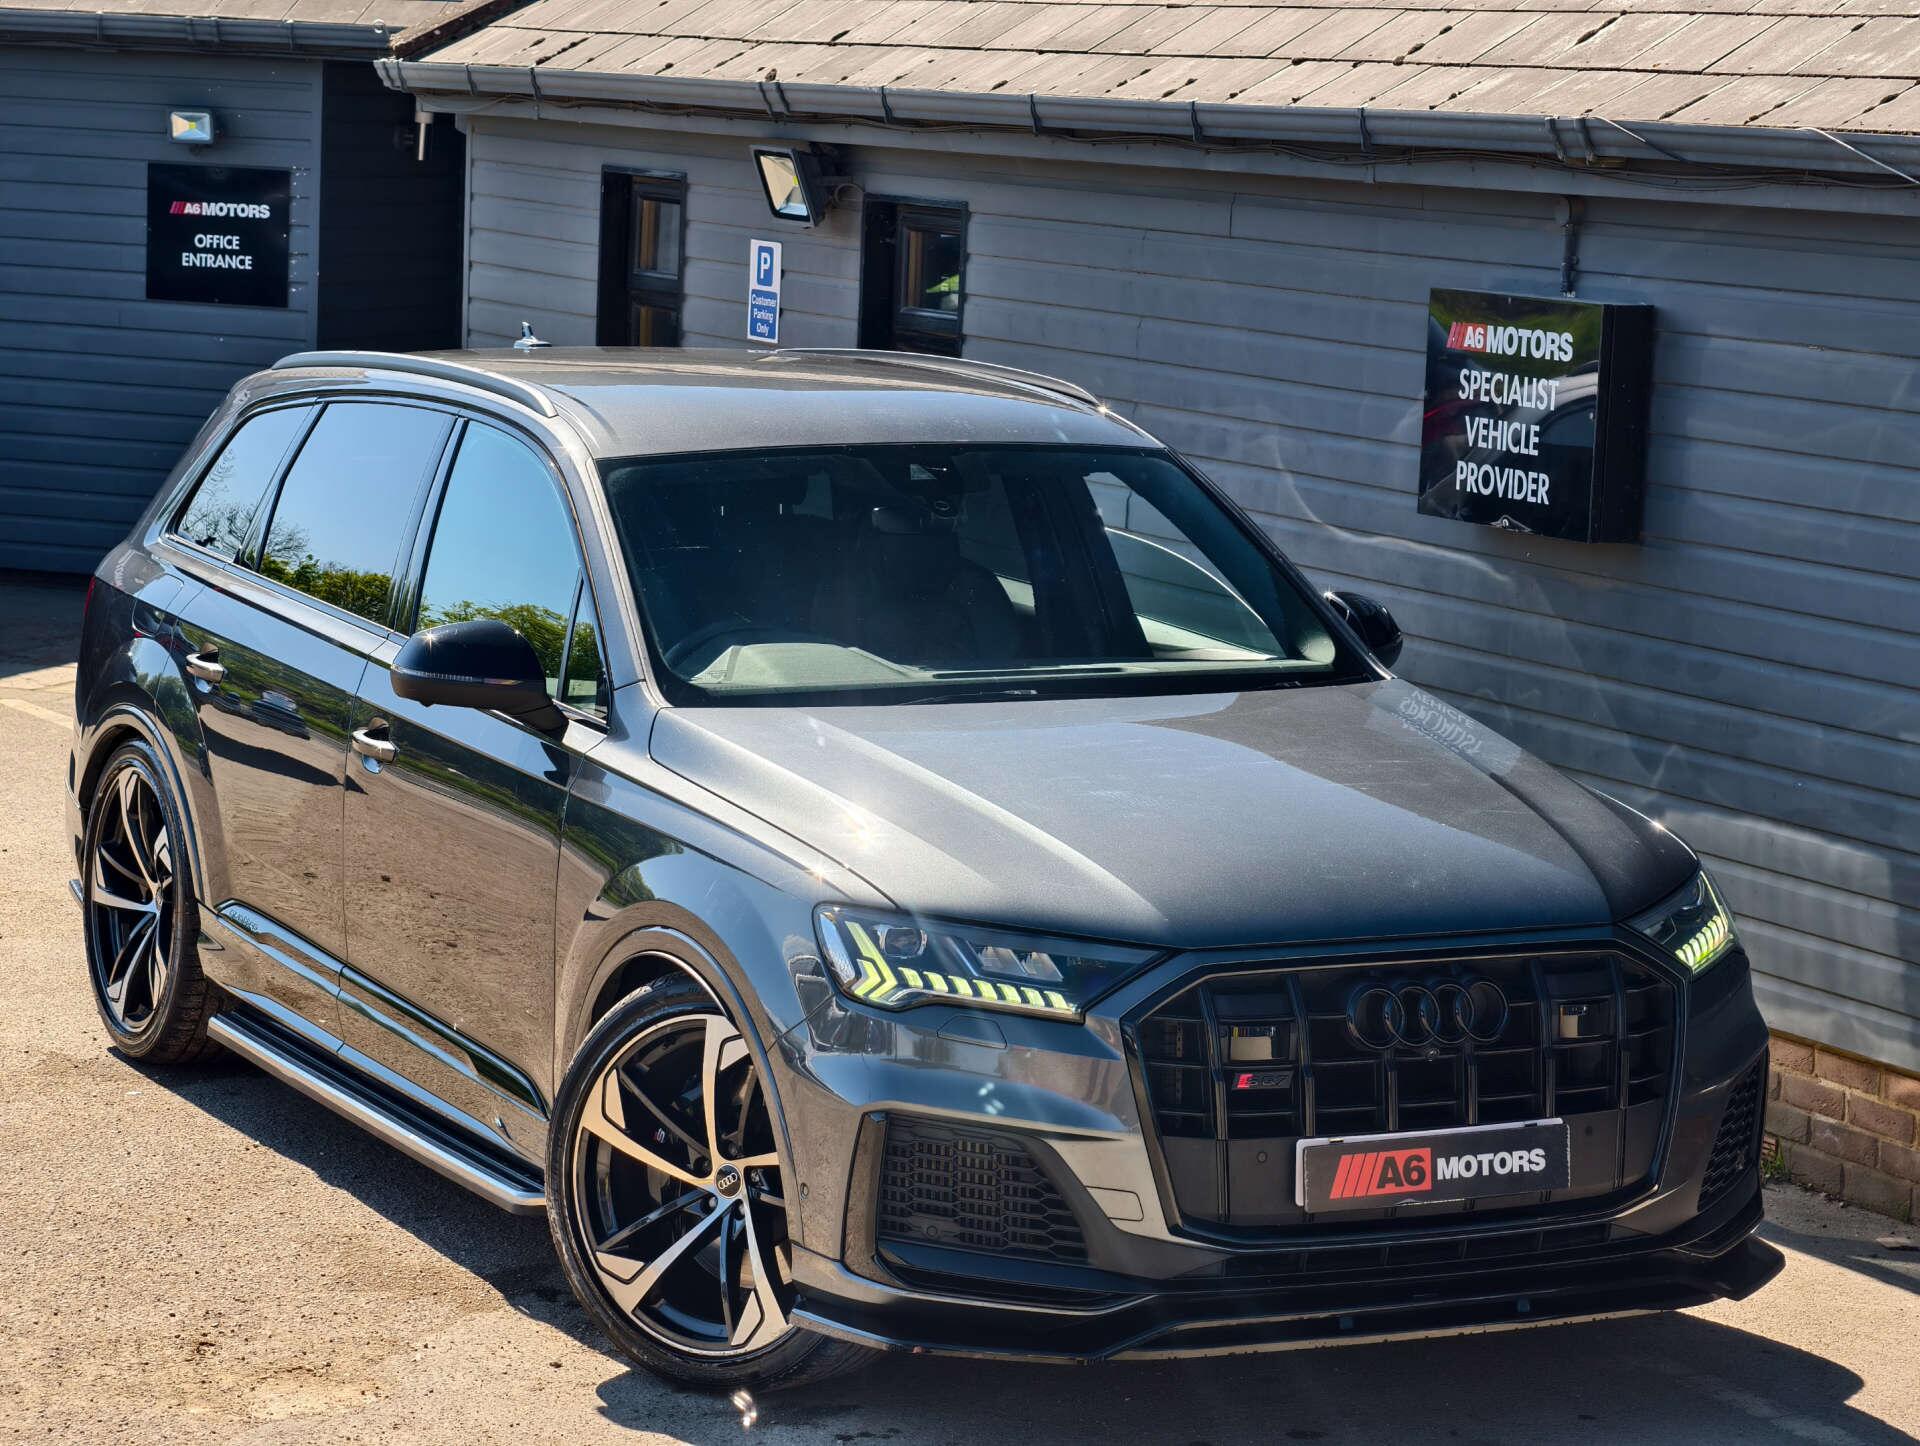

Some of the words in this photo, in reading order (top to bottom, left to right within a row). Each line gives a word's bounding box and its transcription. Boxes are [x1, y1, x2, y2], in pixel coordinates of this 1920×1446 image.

[184, 203, 201, 215] A6
[201, 202, 271, 219] MOTORS
[194, 233, 240, 250] OFFICE
[181, 252, 253, 270] ENTRANCE
[760, 252, 771, 279] P
[751, 294, 777, 307] Customer
[753, 308, 774, 323] Parking
[756, 322, 769, 336] Only
[1464, 325, 1486, 349] A6
[1486, 325, 1574, 362] MOTORS
[1458, 368, 1560, 412] SPECIALIST
[1465, 415, 1540, 457] VEHICLE
[1455, 460, 1551, 505] PROVIDER
[1376, 1154, 1426, 1189] A6
[1436, 1148, 1546, 1180] MOTORS
